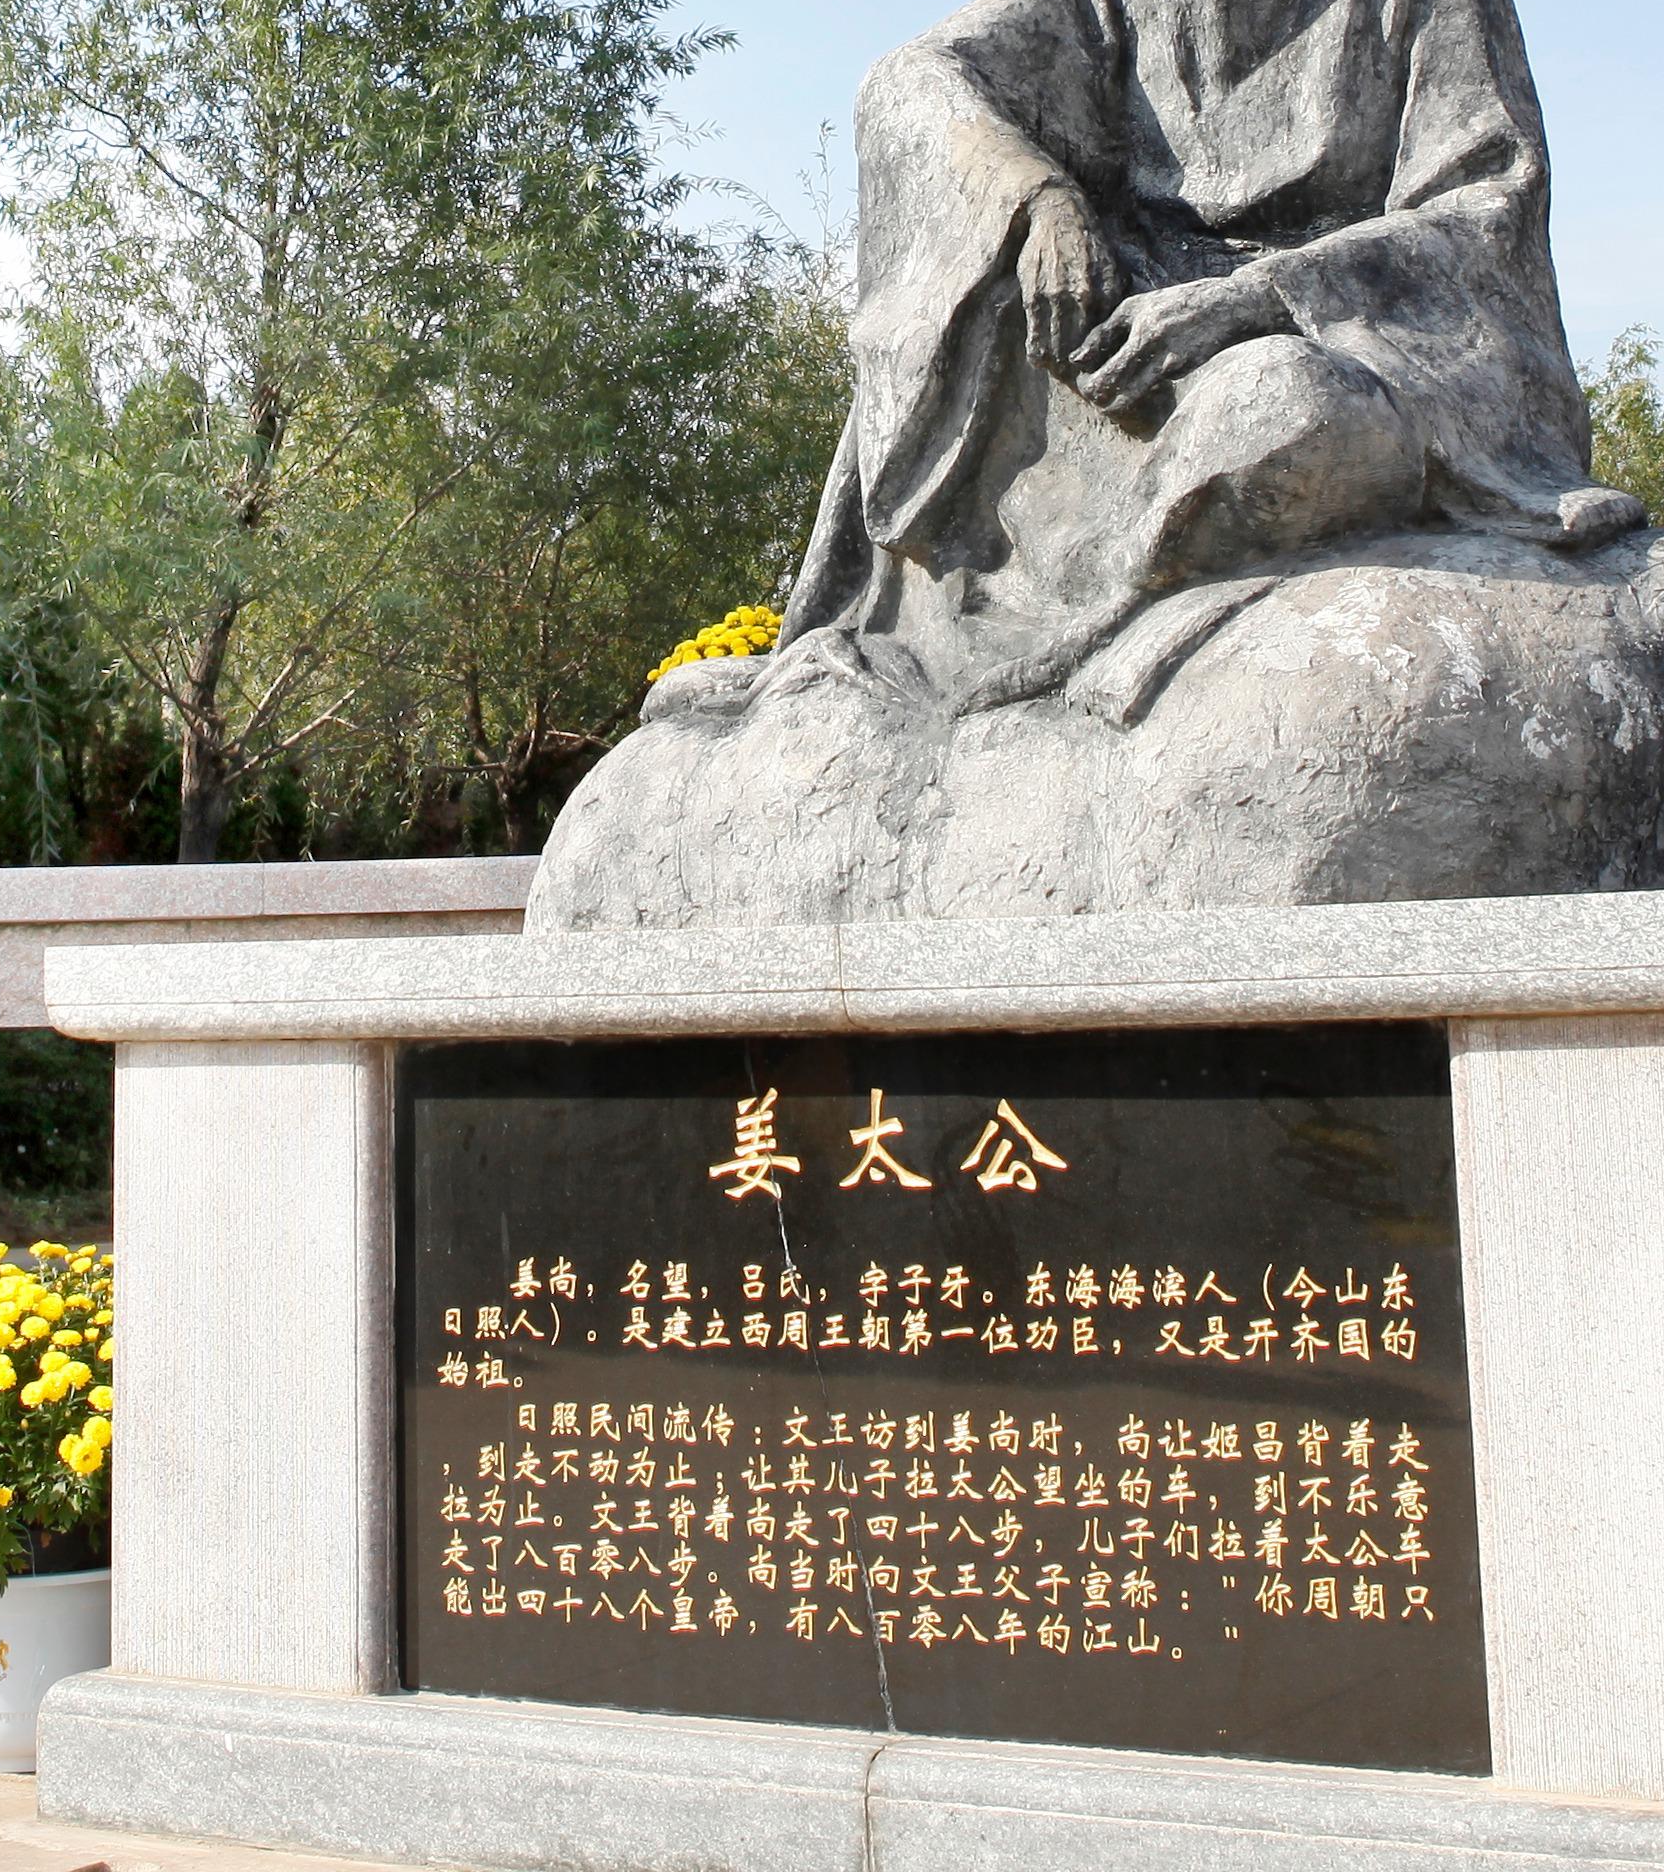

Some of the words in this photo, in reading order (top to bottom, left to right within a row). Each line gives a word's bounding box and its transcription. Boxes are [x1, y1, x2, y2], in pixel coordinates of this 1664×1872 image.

[708, 1087, 1071, 1200] 姜太公
[436, 1350, 524, 1390] 始祖。
